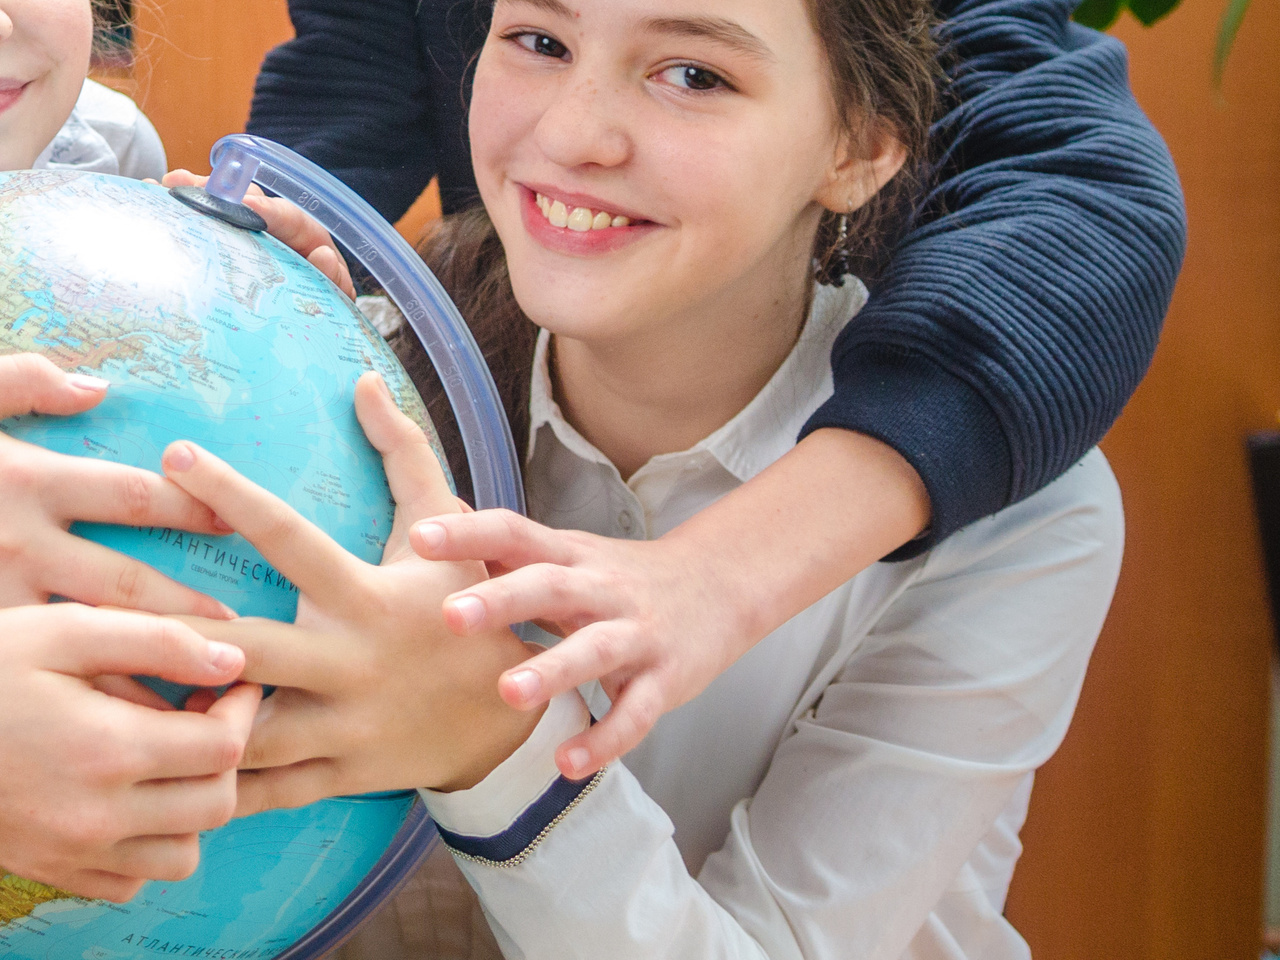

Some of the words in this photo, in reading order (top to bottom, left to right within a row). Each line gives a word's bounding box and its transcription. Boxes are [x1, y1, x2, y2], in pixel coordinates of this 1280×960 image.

[214, 307, 232, 319] МОРЕ
[190, 563, 218, 578] СЕВЕРНЫЙ
[218, 572, 239, 585] ТРОПИК
[121, 933, 260, 959] АТЛАНТИЧЕСКИЙ
